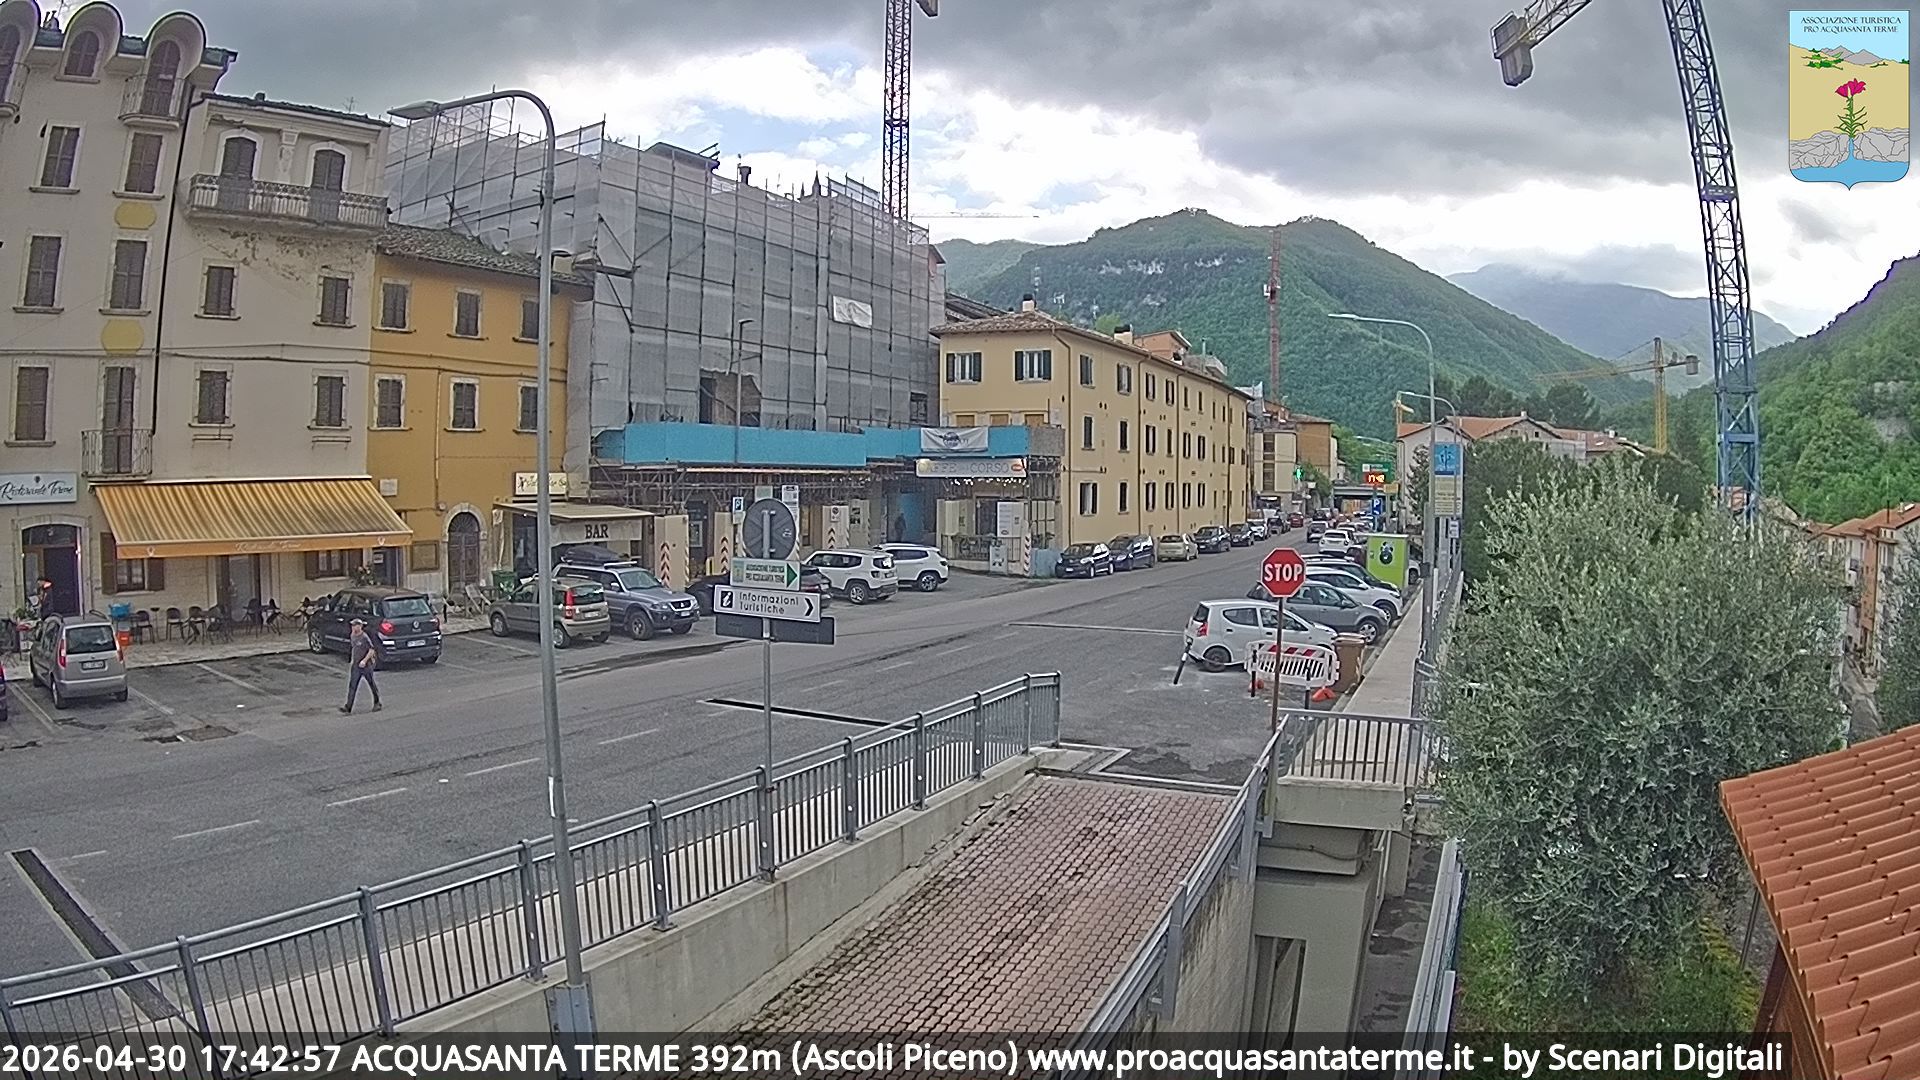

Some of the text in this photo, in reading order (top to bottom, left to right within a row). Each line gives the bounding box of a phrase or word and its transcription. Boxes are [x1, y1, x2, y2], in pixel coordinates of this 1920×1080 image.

[970, 462, 1009, 473] CORSO
[585, 524, 609, 539] BAR
[1264, 563, 1303, 582] STOP
[740, 592, 799, 605] Informazioni
[740, 602, 785, 615] Turistiche
